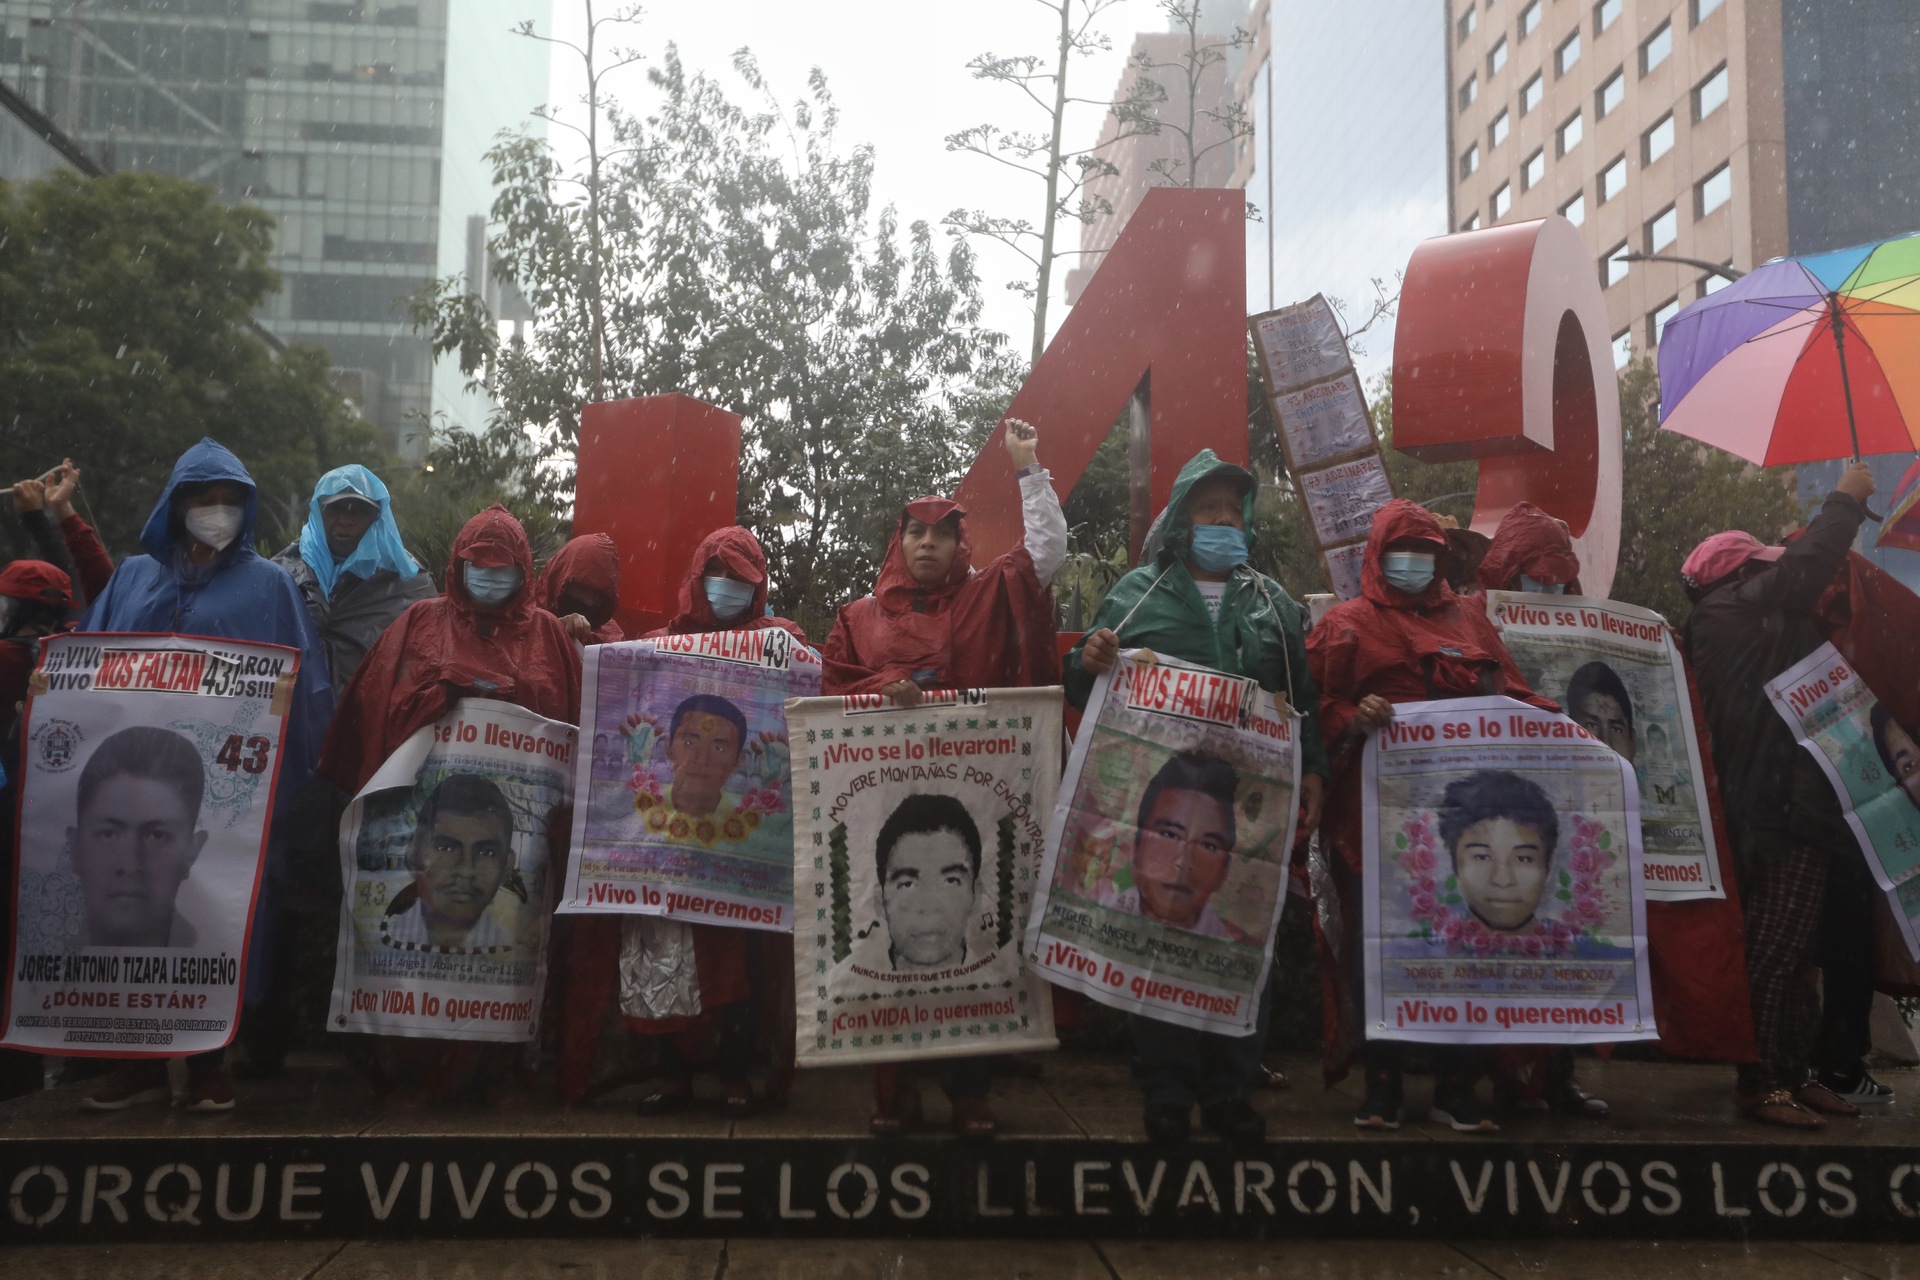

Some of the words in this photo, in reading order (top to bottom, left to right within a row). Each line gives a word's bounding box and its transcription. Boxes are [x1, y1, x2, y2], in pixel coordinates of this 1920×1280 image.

[1308, 475, 1321, 488] 43
[1556, 612, 1576, 626] se
[1580, 609, 1598, 628] lo
[1601, 611, 1662, 643] llevaron!
[699, 629, 764, 662] FALTAN
[762, 628, 791, 669] 43!
[95, 651, 138, 688] NOS
[136, 652, 206, 692] FALTAN
[202, 656, 241, 697] 43!
[1789, 676, 1829, 719] ¡Vivo
[1829, 665, 1849, 688] se
[1129, 663, 1171, 710] NOS
[1171, 671, 1243, 725] FALTAN
[456, 720, 478, 744] lo
[484, 722, 571, 764] llevaron!
[1442, 721, 1472, 740] se
[1479, 716, 1502, 738] lo
[216, 734, 271, 774] 43
[823, 741, 874, 771] ¡Vivo
[879, 744, 901, 761] se
[905, 738, 925, 760] lo
[929, 734, 1017, 759] llevaron!
[828, 769, 878, 823] MOVERE
[880, 762, 958, 785] MONTAÑAS
[963, 765, 994, 788] POR
[586, 882, 637, 906] ¡Vivo
[642, 885, 662, 906] lo
[666, 891, 783, 925] queremos!
[1052, 903, 1095, 930] MIGUEL
[1146, 936, 1199, 961] MENDOZA
[18, 954, 61, 982] JORGE
[64, 955, 119, 984] ANTONIO
[123, 956, 168, 984] TIZAPA
[172, 951, 236, 986] LEGIDEÑO
[374, 956, 393, 967] Luis
[397, 957, 426, 970] Angel
[433, 960, 473, 973] Abarca
[479, 963, 523, 976] Carillo
[850, 963, 880, 982] NUNCA
[880, 971, 919, 984] ESPERES
[920, 972, 939, 983] QUE
[940, 970, 952, 980] TE
[953, 951, 998, 977] OLVIDEMOS
[1045, 941, 1097, 978] ¡Vivo
[1102, 962, 1125, 988] lo
[1130, 975, 1241, 1016] queremos!
[1403, 966, 1445, 979] JORGE
[1512, 966, 1546, 979] CRUZ
[1554, 968, 1616, 981] MENDOZA
[41, 988, 120, 1010] ¿DÓNDE
[127, 990, 208, 1010] ESTÁN?
[350, 987, 379, 1014] ¡Con
[381, 989, 415, 1016] VIDA
[420, 992, 440, 1017] lo
[445, 998, 532, 1023] queremos!
[832, 1010, 869, 1036] ¡Con
[871, 1006, 912, 1028] VIDA
[914, 1005, 930, 1024] lo
[934, 996, 1015, 1025] queremos!
[1397, 1000, 1458, 1028] ¡Vivo
[1466, 1000, 1488, 1023] lo
[1495, 1002, 1624, 1029] queremos!
[16, 1015, 50, 1028] CONTRA
[50, 1016, 61, 1028] EL
[62, 1017, 113, 1029] TERRORISMO
[113, 1018, 125, 1030] DE
[161, 1019, 173, 1031] LA
[174, 1019, 227, 1032] SOLIDARIDAD
[64, 1031, 115, 1044] AYOTZINAPA
[115, 1033, 144, 1044] SOMOS
[145, 1033, 173, 1045] TODOS
[359, 1160, 612, 1221] VIVOS
[645, 1161, 746, 1219] SE
[779, 1161, 933, 1220] LOS
[976, 1160, 1421, 1225] LLEVARON,
[1449, 1159, 1683, 1216] VIVOS
[1711, 1161, 1857, 1218] LOS
